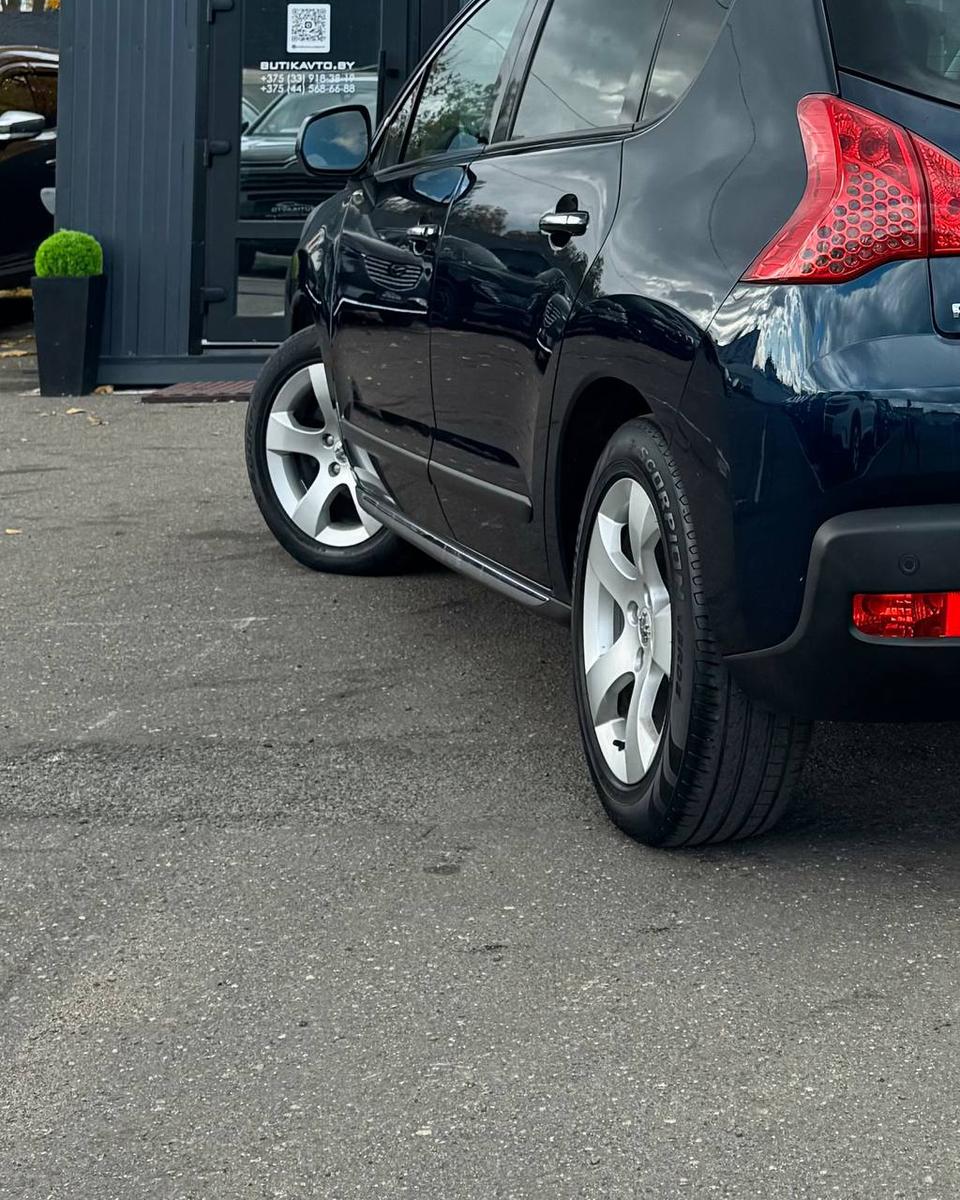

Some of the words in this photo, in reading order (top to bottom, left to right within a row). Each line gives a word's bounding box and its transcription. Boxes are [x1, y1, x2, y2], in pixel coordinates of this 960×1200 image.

[260, 61, 356, 70] BUTIKAVTO.BY
[261, 73, 285, 84] +375
[287, 73, 305, 85] (33)
[261, 83, 284, 94] +375
[287, 83, 305, 96] (44)
